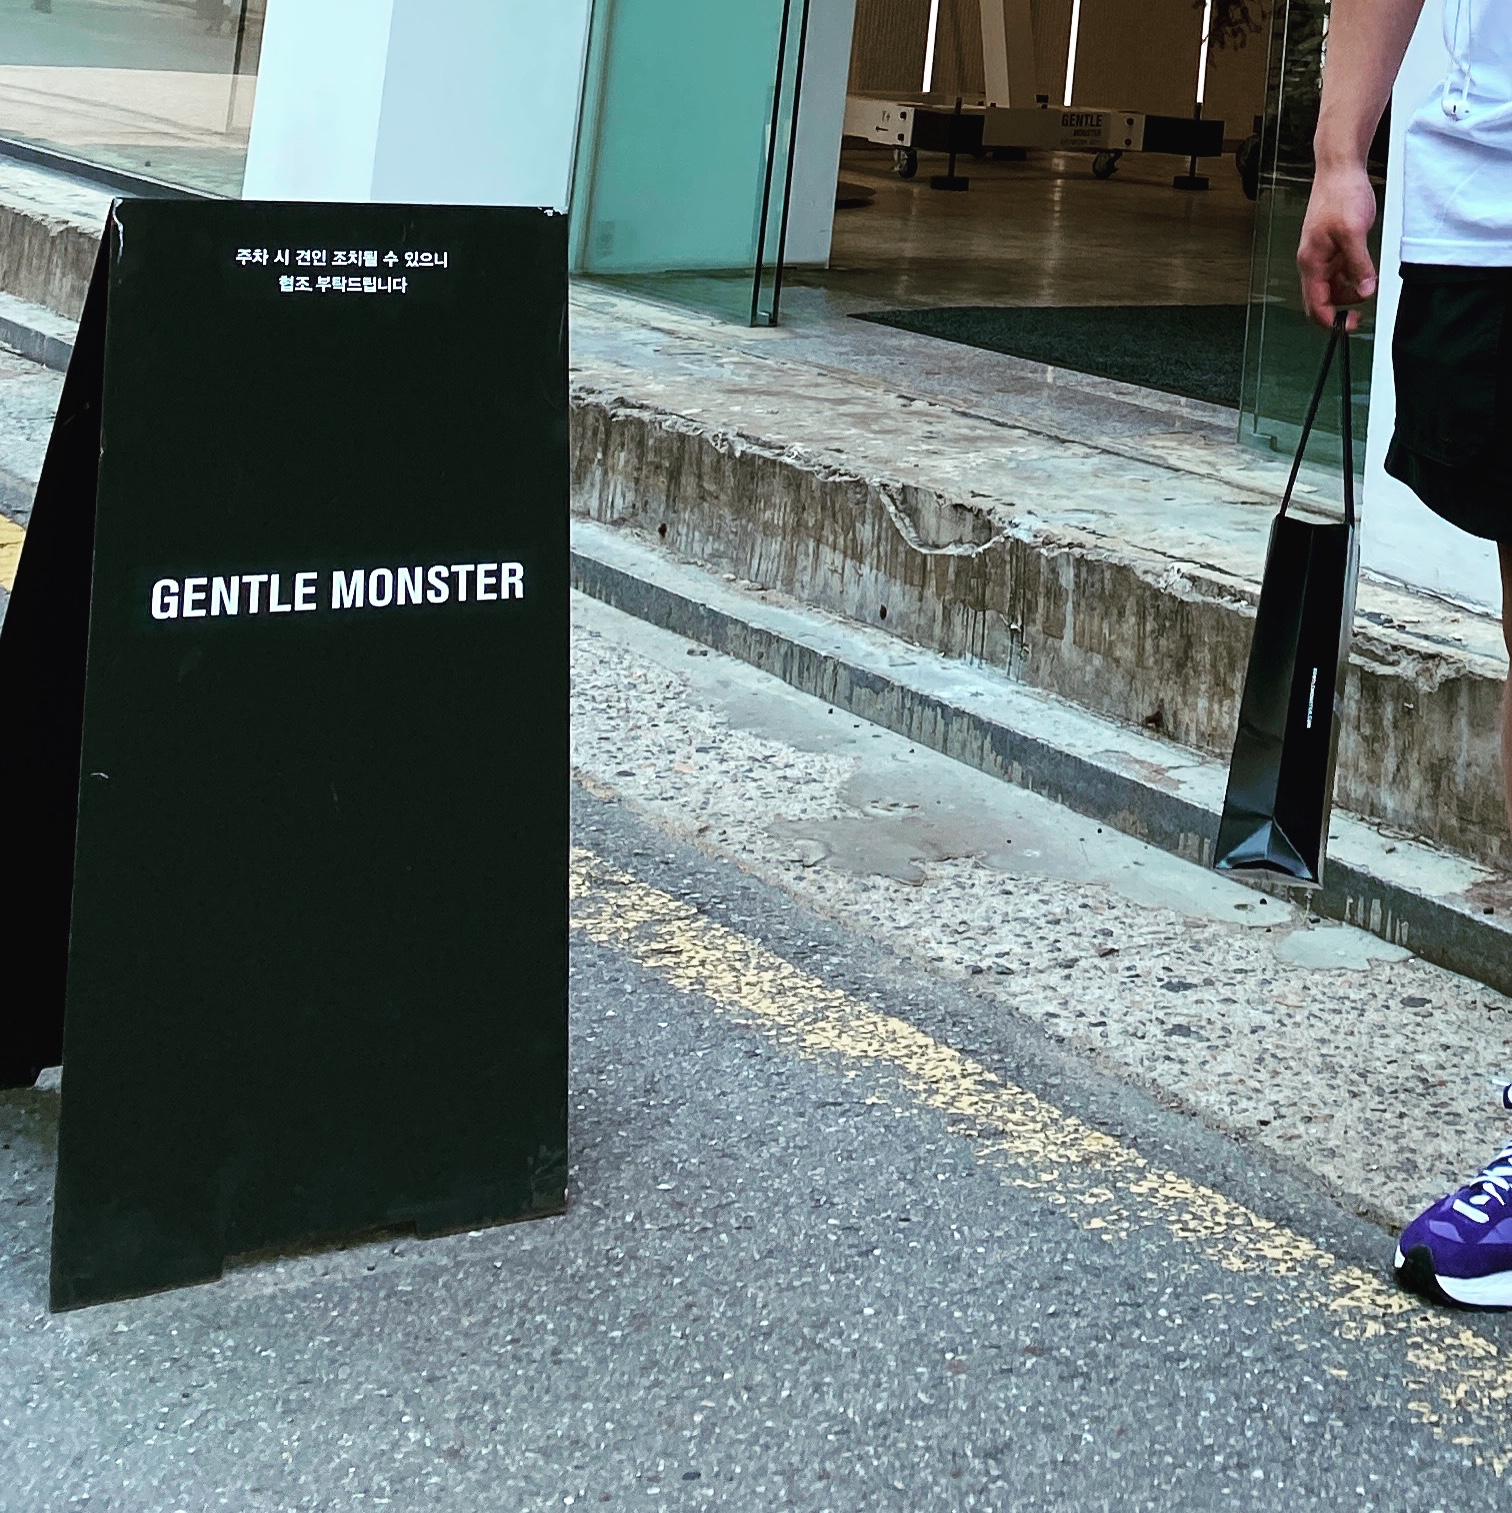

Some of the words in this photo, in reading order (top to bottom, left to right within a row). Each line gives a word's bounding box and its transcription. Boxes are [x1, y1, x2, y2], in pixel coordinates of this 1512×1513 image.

[1061, 113, 1103, 127] GENTLE
[236, 248, 269, 266] 주차
[273, 248, 290, 266] 시
[296, 249, 327, 267] 견인
[331, 250, 378, 268] 조치될
[383, 250, 400, 268] 수
[404, 251, 448, 269] 있으니
[278, 274, 313, 293] 협조
[315, 275, 408, 294] 부탁드립니다
[151, 571, 318, 620] GENTLE
[331, 561, 524, 610] MONSTER
